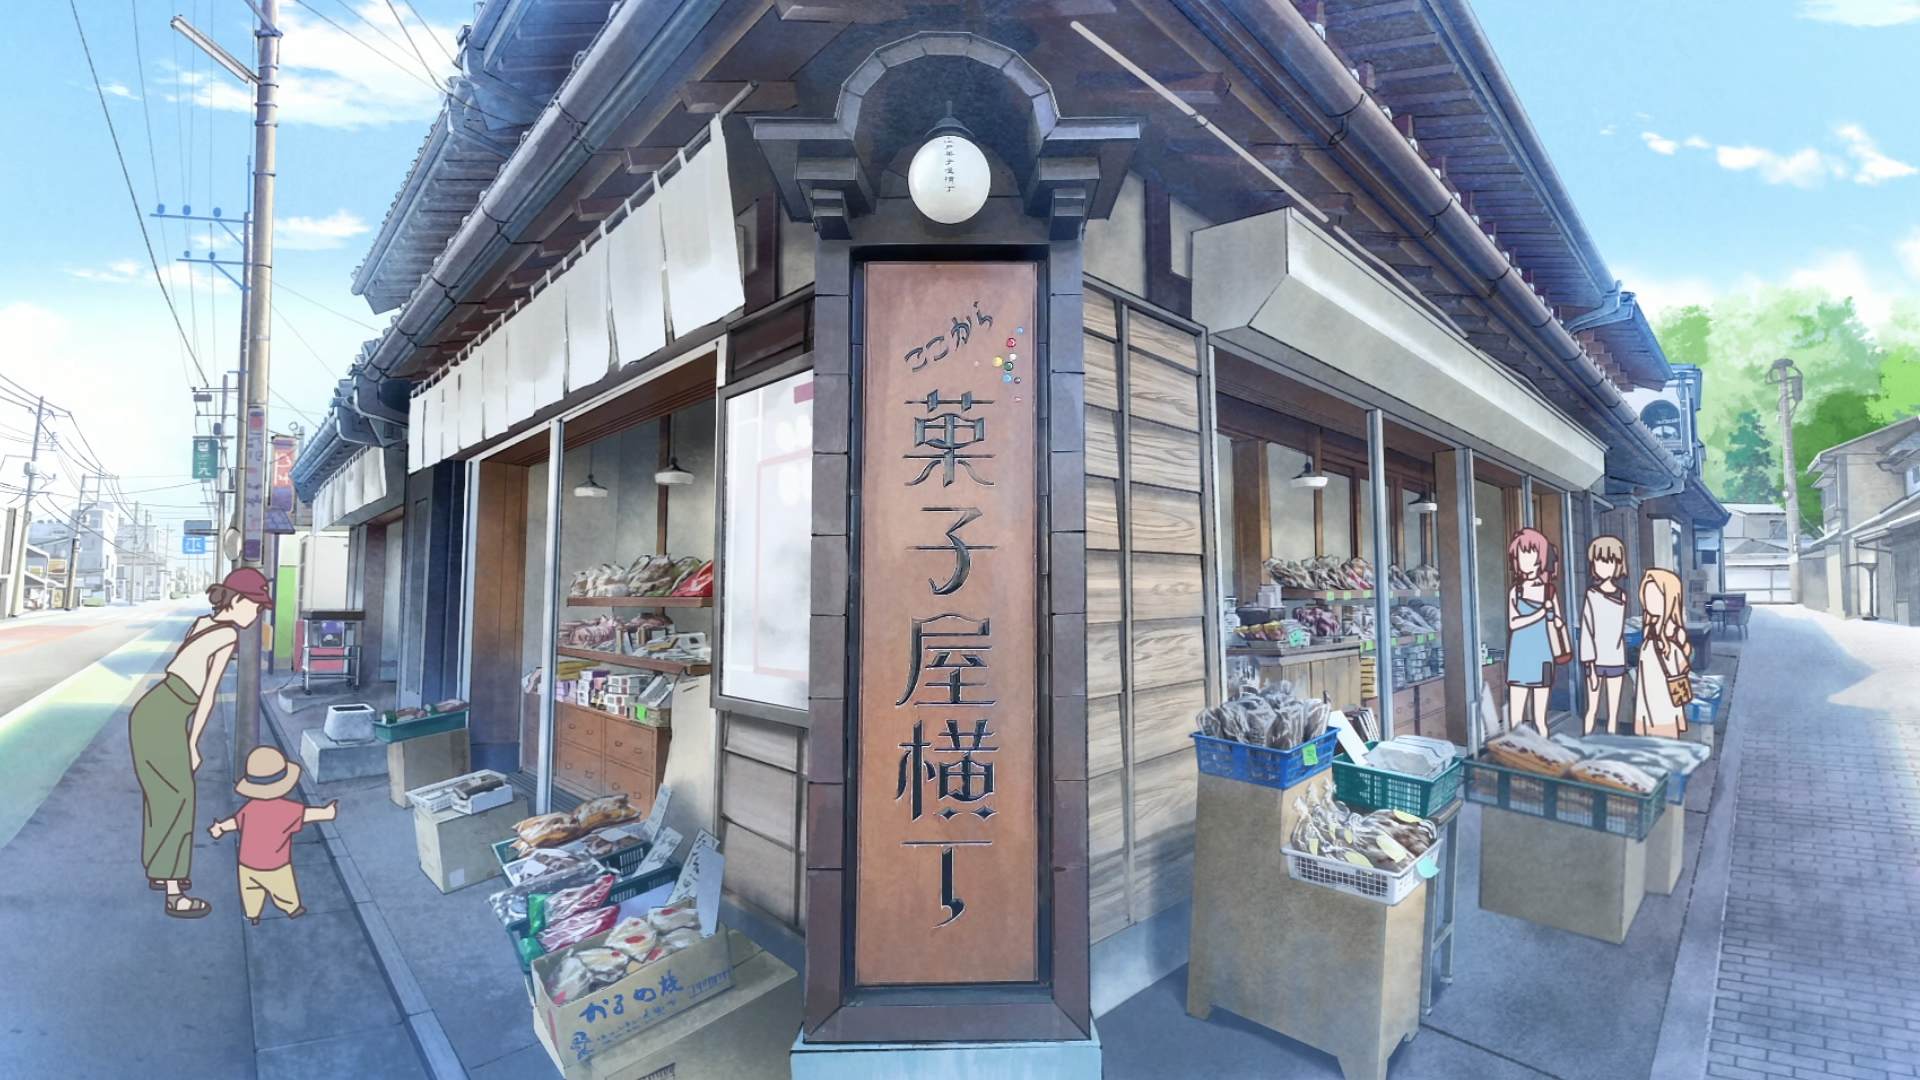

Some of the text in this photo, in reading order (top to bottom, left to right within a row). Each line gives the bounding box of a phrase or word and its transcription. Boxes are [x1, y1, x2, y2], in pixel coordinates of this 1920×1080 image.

[904, 301, 993, 372] ここから
[896, 389, 999, 929] 菓子屋横丁
